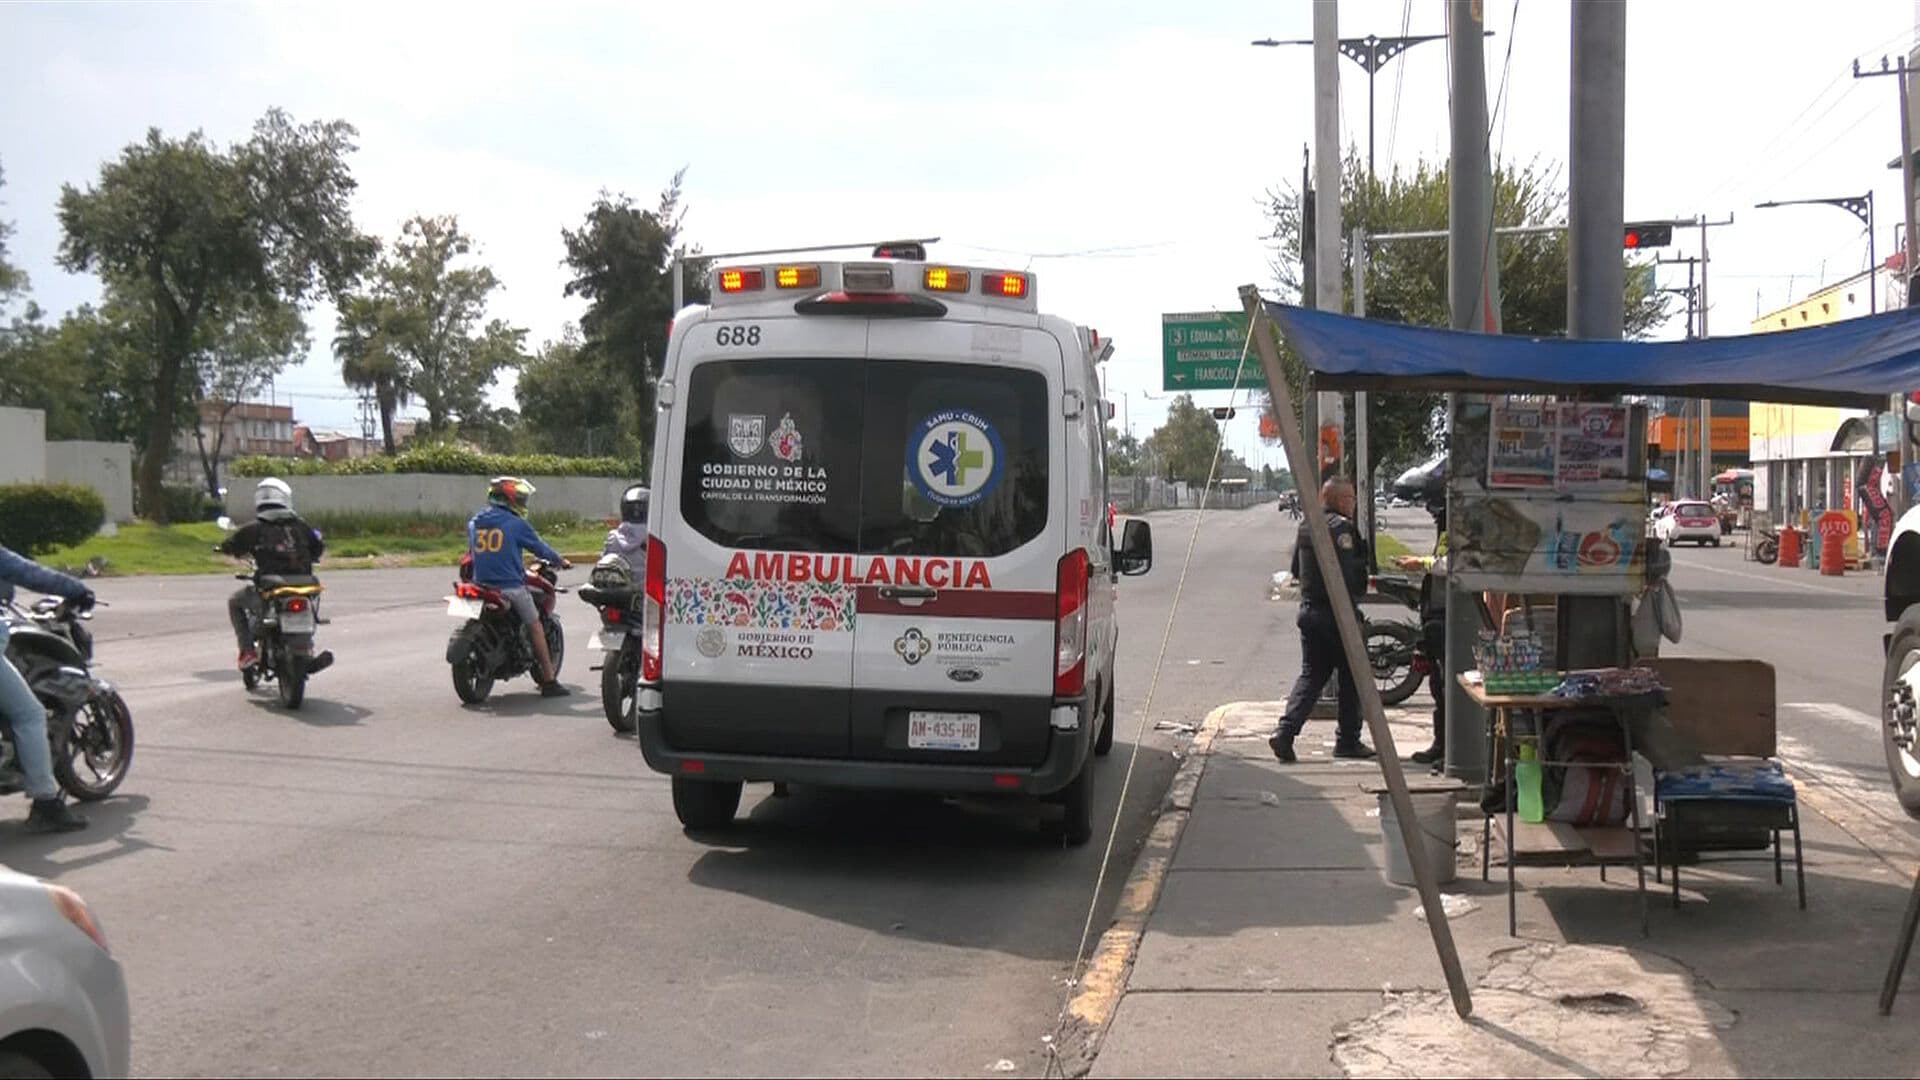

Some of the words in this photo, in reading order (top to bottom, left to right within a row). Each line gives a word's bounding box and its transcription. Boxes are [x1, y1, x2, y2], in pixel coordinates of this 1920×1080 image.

[715, 325, 761, 347] 688
[926, 412, 954, 428] SAMU
[961, 412, 989, 430] CRUM
[703, 463, 778, 477] GOBIERNO
[783, 466, 803, 478] DE
[808, 467, 827, 479] LA
[702, 477, 750, 489] CIUDAD
[754, 479, 772, 490] DE
[775, 480, 827, 493] MÉXICO
[701, 492, 731, 500] CAPITAL
[732, 493, 742, 501] DE
[743, 493, 754, 501] LA
[1820, 521, 1851, 535] ALTO
[475, 528, 504, 552] 30
[725, 551, 992, 589] AMBULANCIA
[737, 632, 796, 643] GOBIERNO
[798, 634, 814, 644] DE
[937, 632, 1016, 645] BENEFICENCIA
[737, 643, 814, 660] MÉXICO
[937, 643, 984, 653] PÚBLICA
